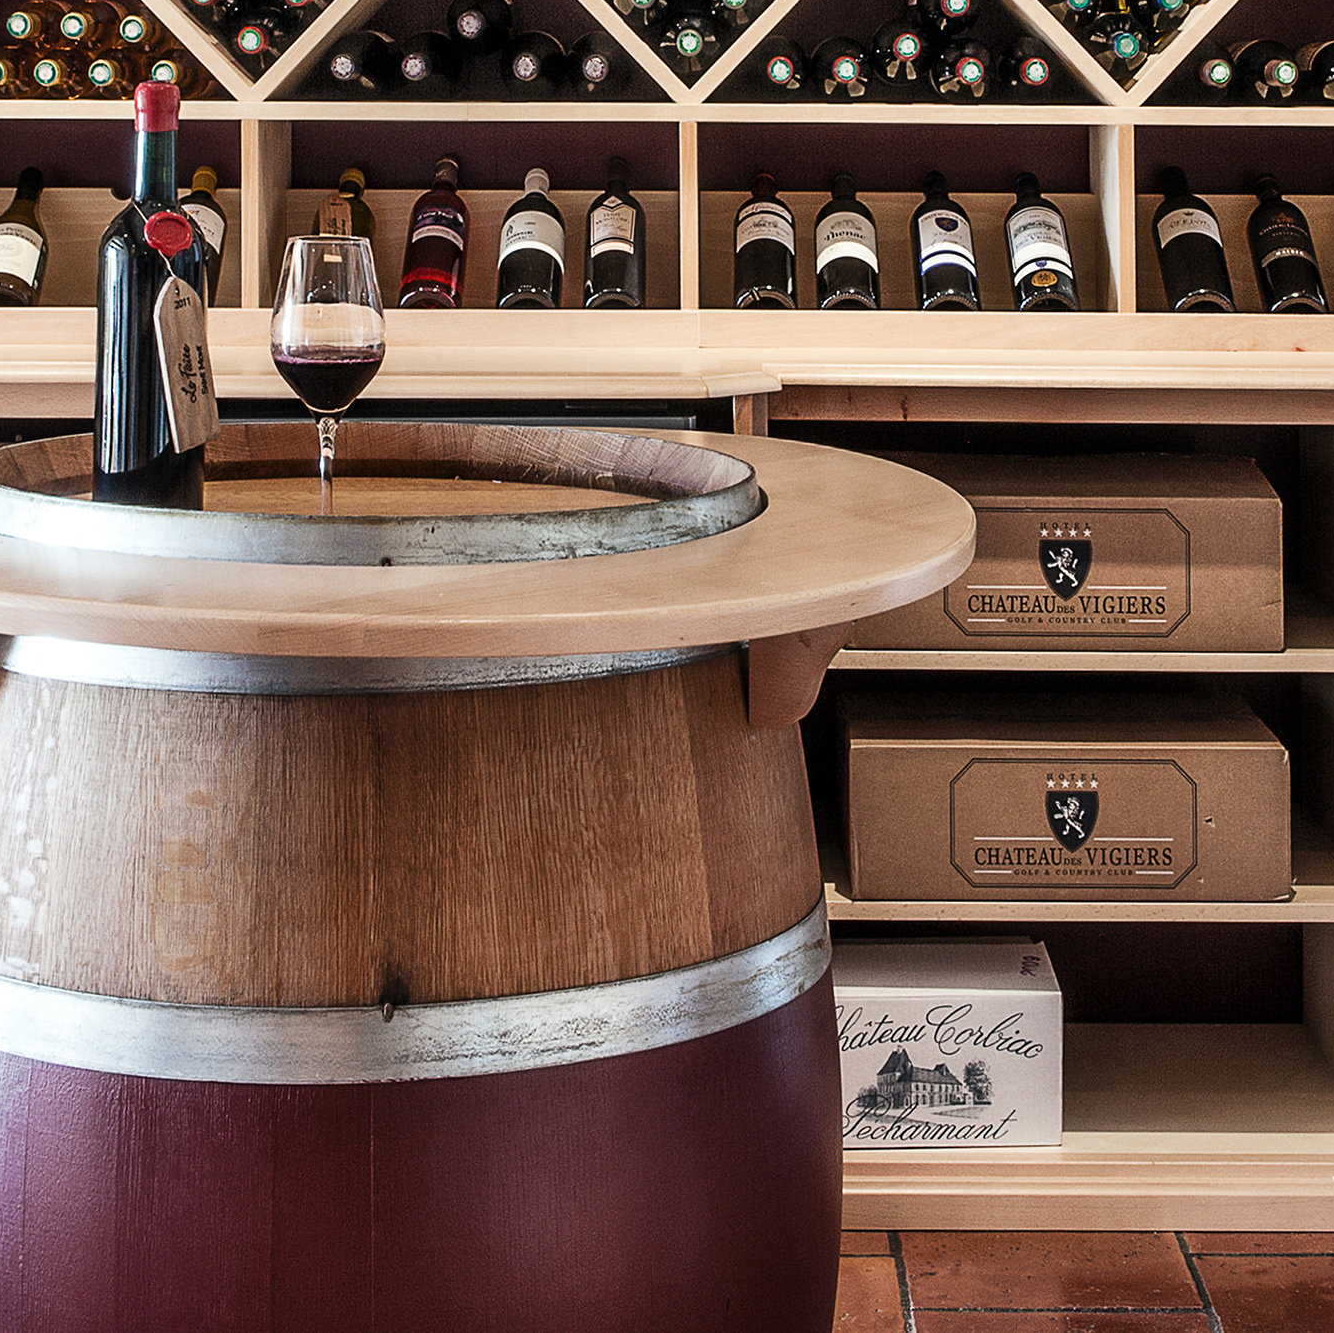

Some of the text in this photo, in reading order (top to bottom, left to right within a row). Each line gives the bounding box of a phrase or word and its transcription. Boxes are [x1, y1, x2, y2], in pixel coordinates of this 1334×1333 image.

[174, 297, 191, 310] 2011
[968, 595, 1166, 615] CHATEAU DES VIGIERS
[974, 847, 1173, 866] CHATEAU DES VIGIERS
[835, 1004, 1043, 1058] hâteau Corbiac
